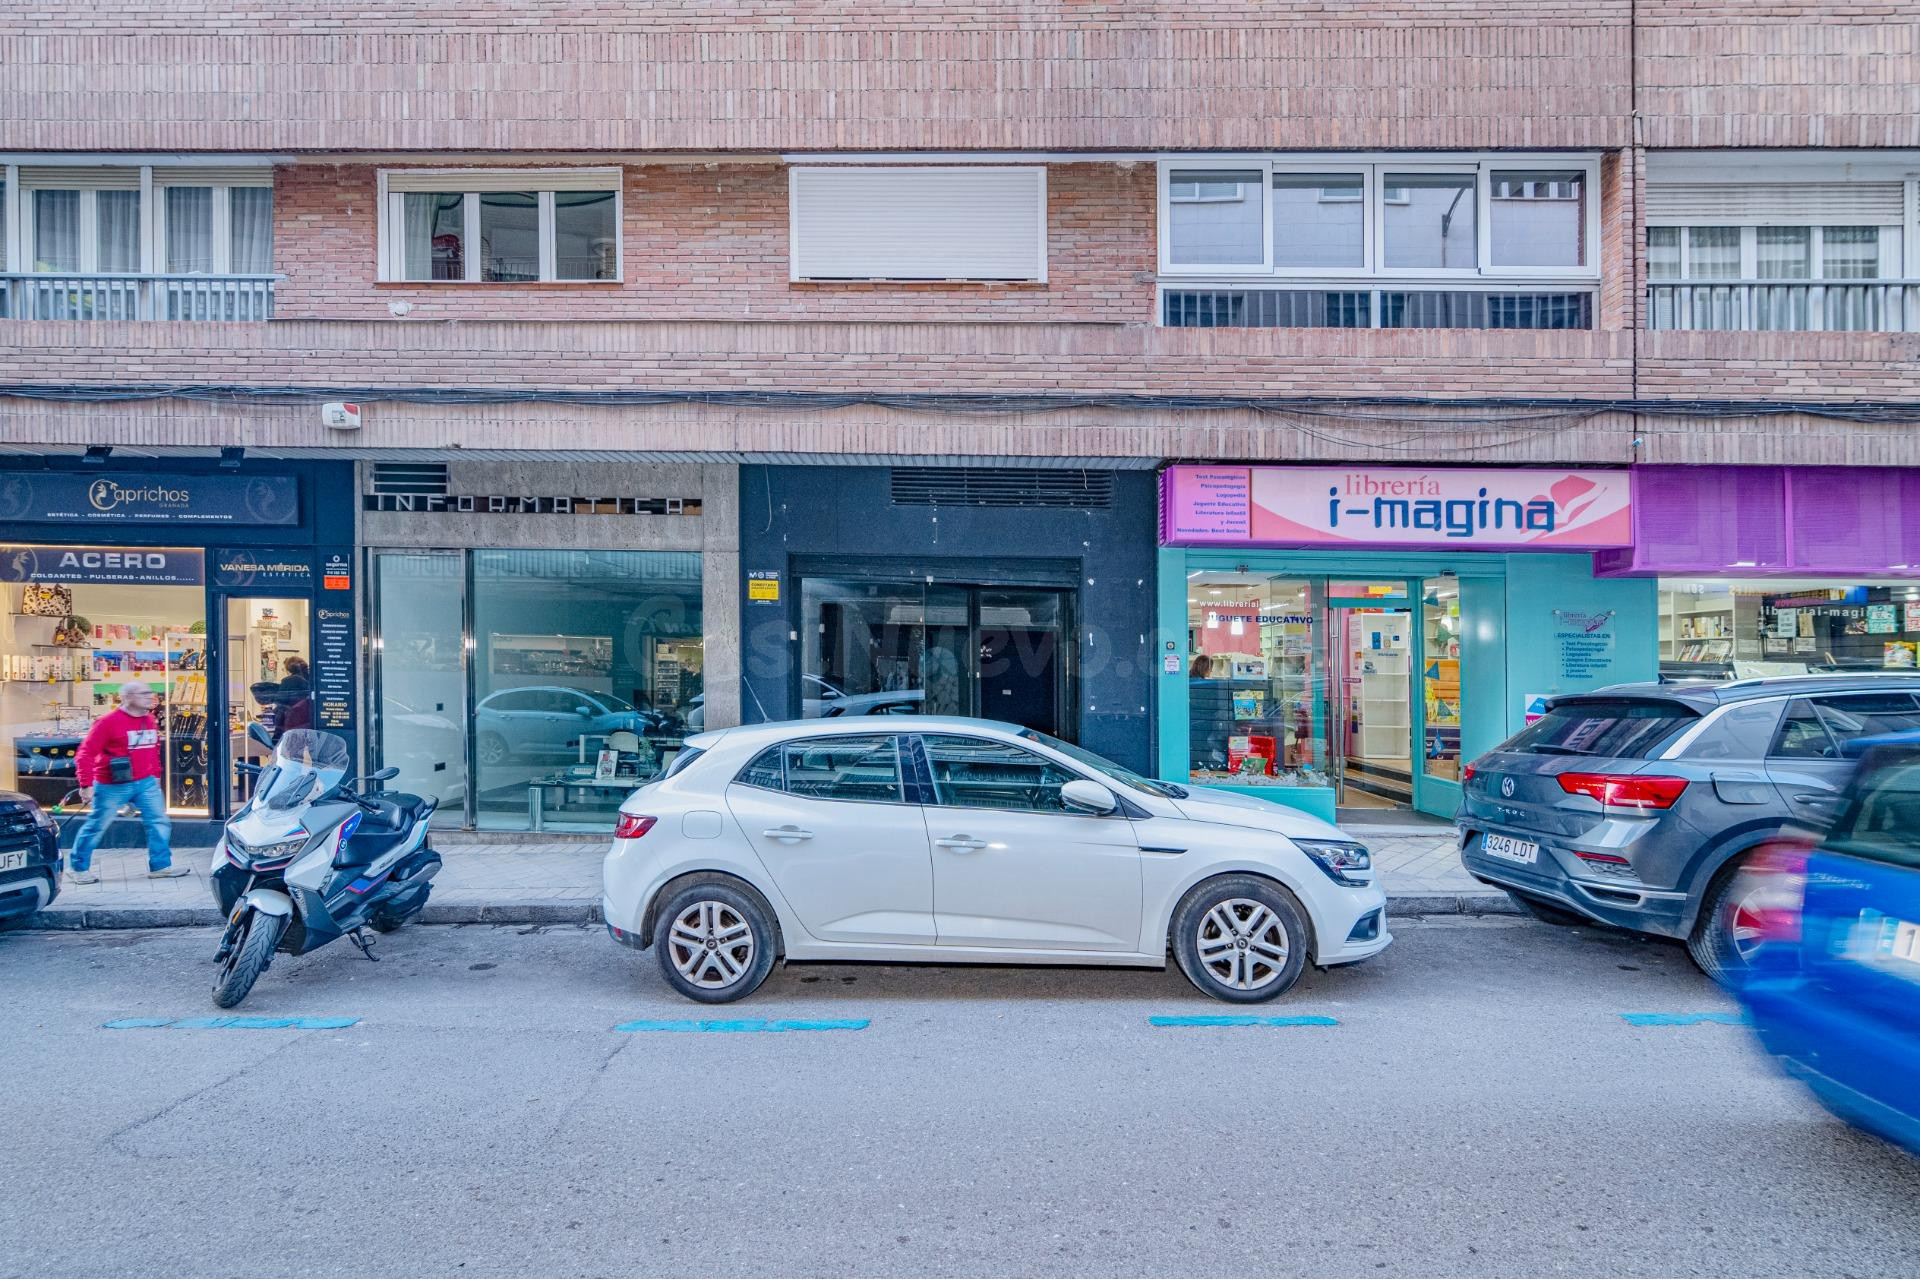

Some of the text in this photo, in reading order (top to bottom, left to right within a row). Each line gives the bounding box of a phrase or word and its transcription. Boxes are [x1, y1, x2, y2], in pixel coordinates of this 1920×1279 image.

[1345, 474, 1441, 496] librería
[377, 494, 683, 514] INFORMATICA
[1329, 486, 1555, 538] i-magina
[59, 552, 166, 569] ACERO
[220, 562, 310, 572] VANESA MÉRIDA
[1255, 614, 1314, 624] EDUCATIVO
[1487, 835, 1536, 859] 3246 LDT
